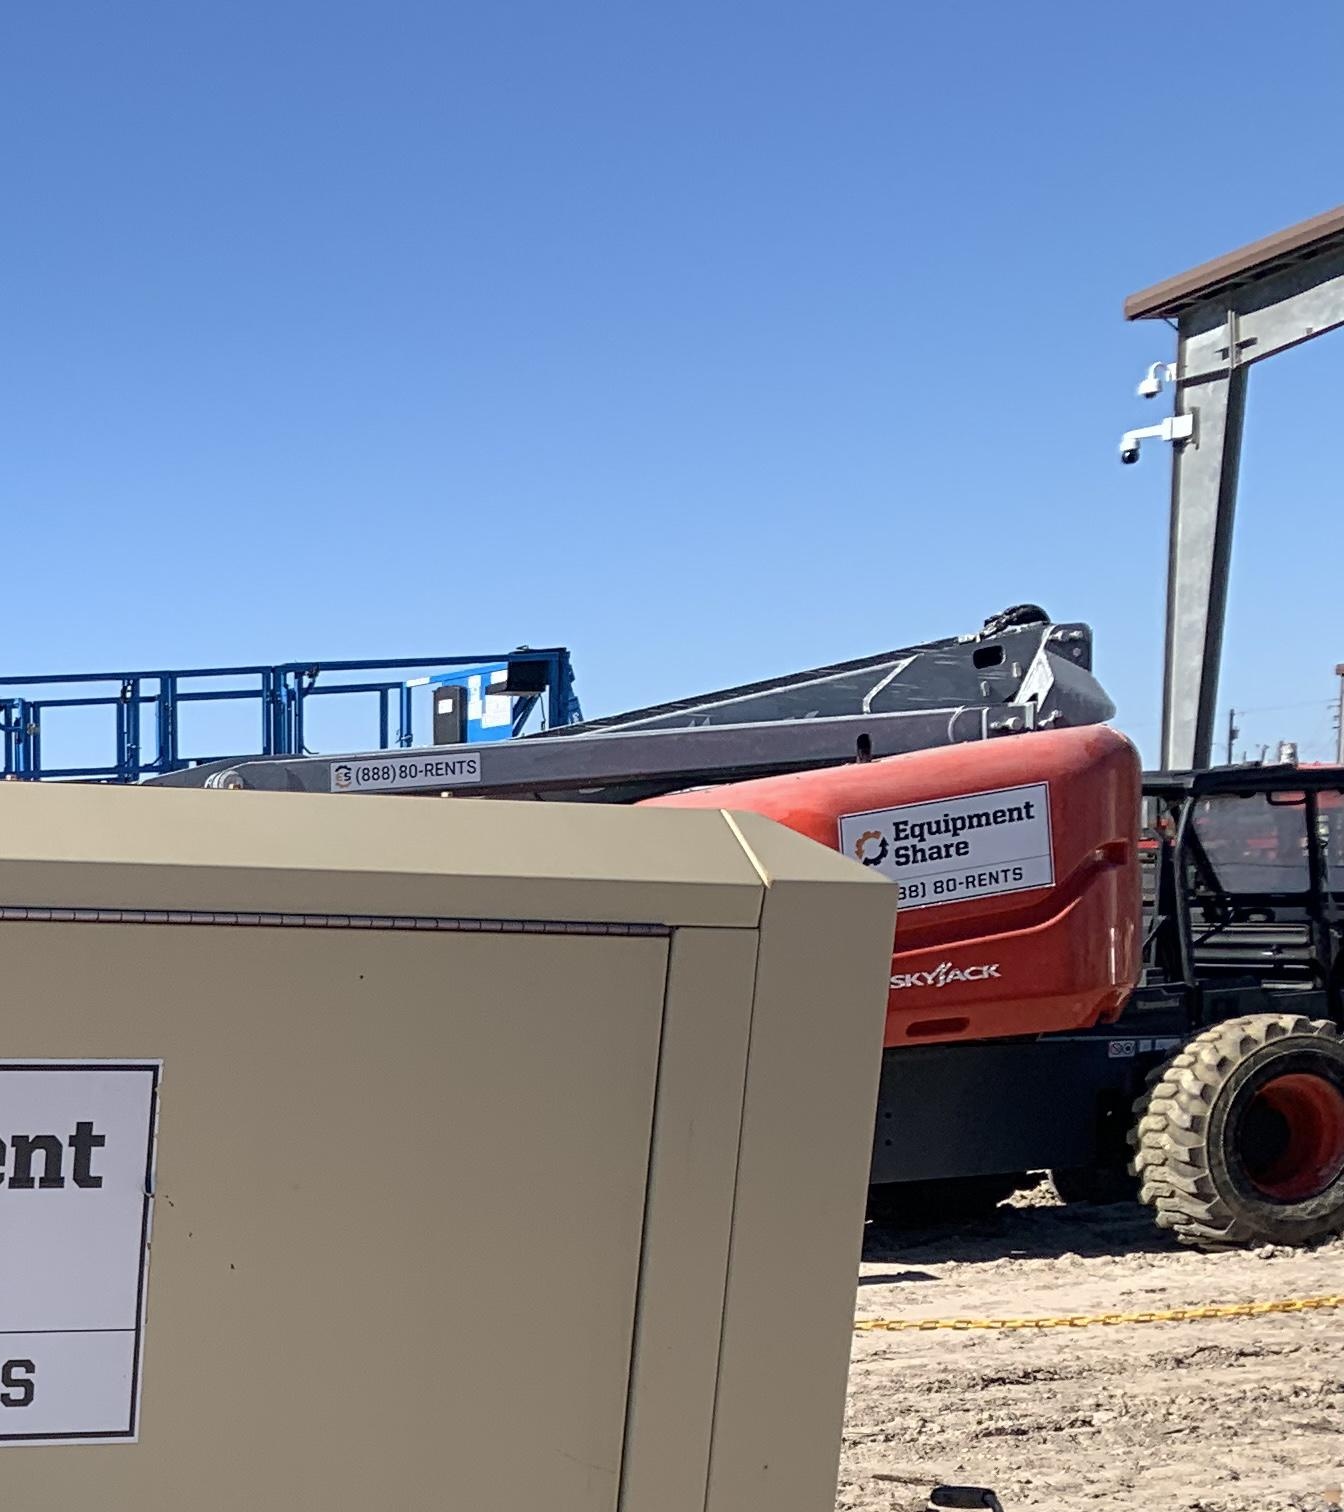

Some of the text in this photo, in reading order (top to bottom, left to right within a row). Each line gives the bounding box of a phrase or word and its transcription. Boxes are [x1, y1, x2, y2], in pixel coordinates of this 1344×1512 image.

[355, 764, 396, 785] (888)
[398, 759, 477, 779] 80-RENTS
[893, 801, 1035, 843] Equipment
[894, 840, 970, 867] Share
[933, 866, 1024, 895] 80-RENTS
[890, 961, 1002, 989] SKYJACK
